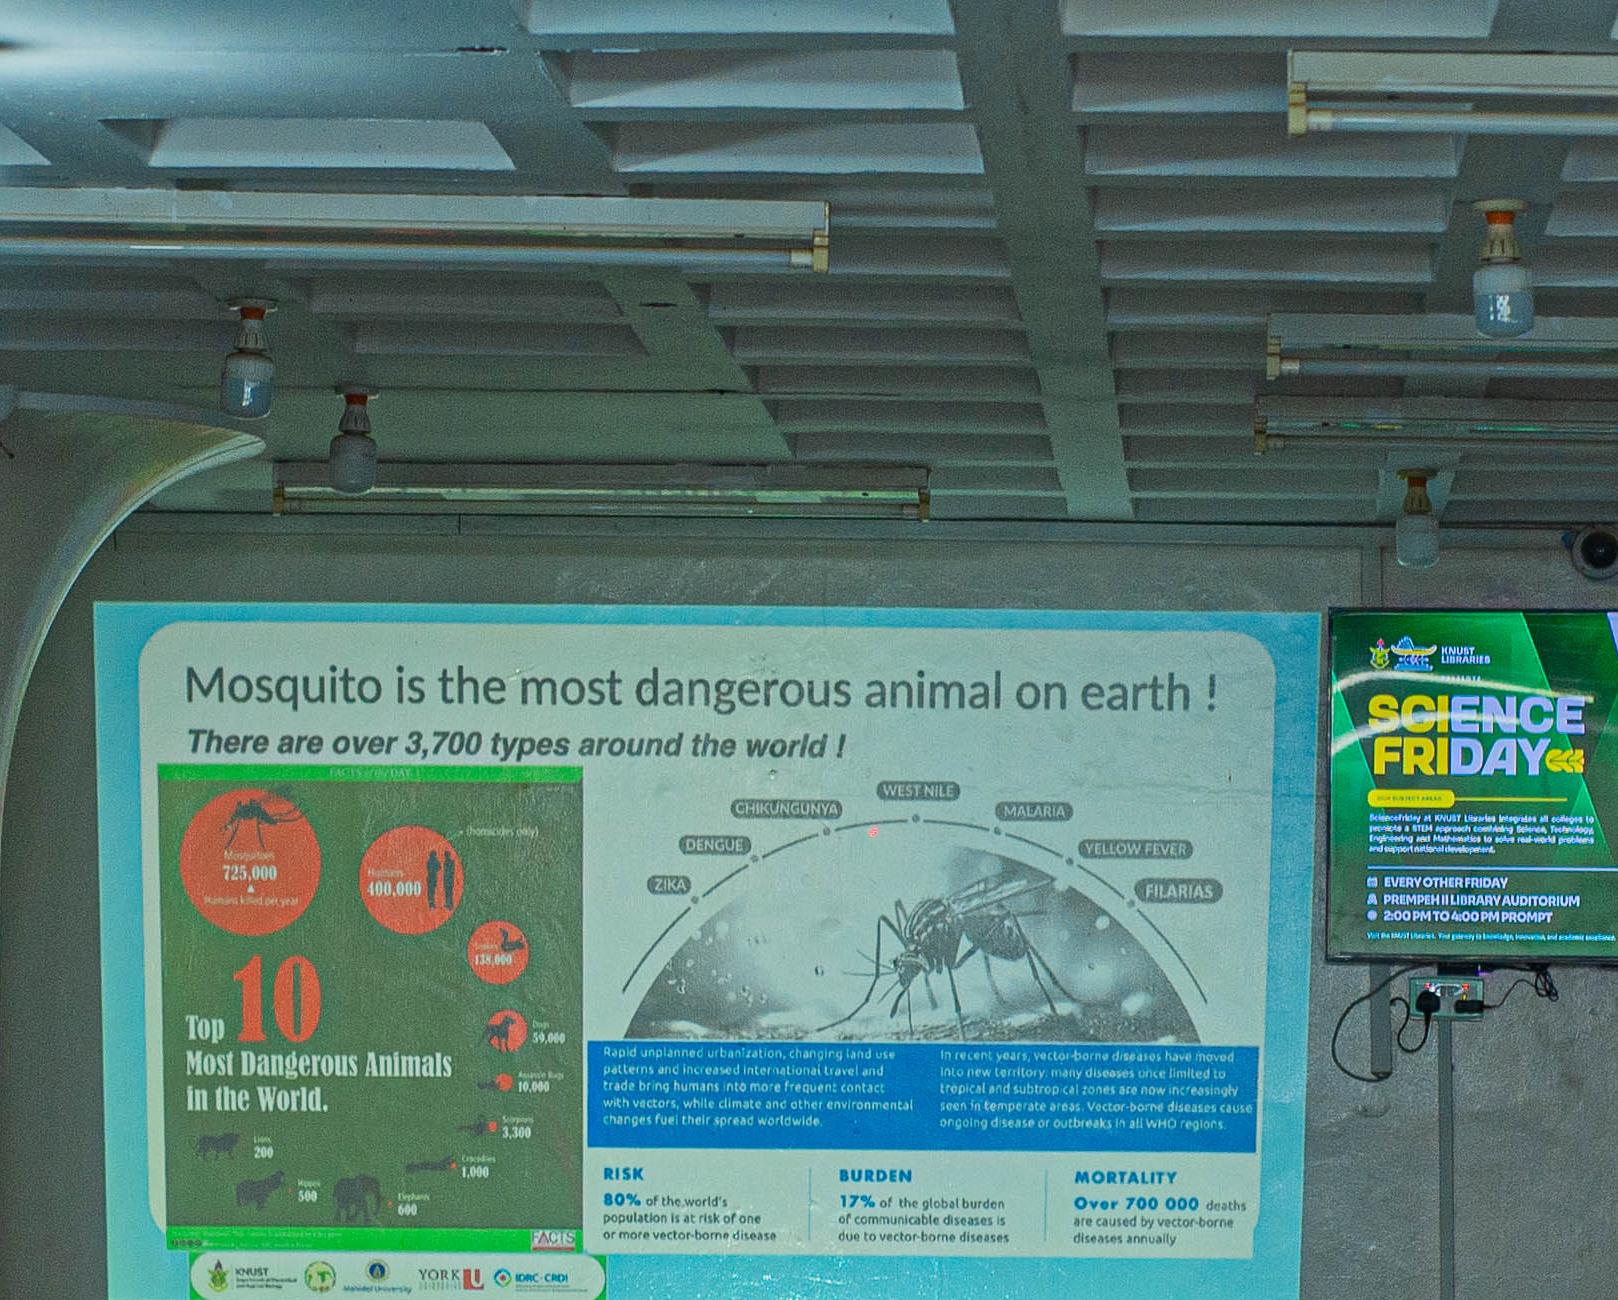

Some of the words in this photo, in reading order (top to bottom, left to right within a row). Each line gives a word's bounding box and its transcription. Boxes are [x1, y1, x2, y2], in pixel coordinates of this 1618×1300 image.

[1441, 646, 1475, 655] KNUST
[1441, 655, 1490, 664] LIBRARIES
[186, 665, 382, 711] Mosquito
[396, 665, 425, 705] is
[438, 667, 506, 706] the
[521, 671, 621, 706] most
[636, 667, 851, 715] dangerous
[865, 670, 1002, 709] animal
[1016, 681, 1067, 710] on
[1081, 672, 1190, 712] earth
[1207, 673, 1216, 712] !
[1369, 695, 1585, 734] SCIENCE
[188, 729, 269, 754] There
[277, 735, 323, 755] are
[333, 736, 397, 755] over
[405, 731, 482, 760] 3,700
[491, 733, 570, 762] types
[579, 733, 683, 757] around
[692, 733, 735, 757] the
[747, 734, 827, 758] world
[836, 734, 846, 758] !
[1373, 737, 1551, 775] FRIDAY
[882, 786, 920, 796] WEST
[924, 785, 954, 797] NILE
[736, 804, 838, 815] CHIKUNGUNYA
[1004, 806, 1066, 817] MALARIA
[686, 839, 744, 850] DENGUE
[1084, 844, 1140, 855] YELLOW
[1145, 844, 1186, 856] FEVER
[223, 865, 277, 883] 725,000
[367, 881, 421, 897] 400,000
[654, 880, 686, 890] ZIKA
[1384, 877, 1421, 888] EVERY
[1423, 877, 1463, 888] OTHER
[1464, 877, 1508, 889] FRIDAY
[1146, 884, 1213, 898] FILARIAS
[1384, 894, 1440, 905] PREMPEH
[1442, 895, 1448, 905] II
[1451, 895, 1502, 906] LIBRARY
[1502, 895, 1580, 907] AUDITORIUM
[1384, 911, 1411, 921] 2:00
[1413, 911, 1431, 921] PM
[1433, 911, 1450, 921] TO
[1451, 911, 1479, 921] 4:00
[1481, 911, 1500, 922] PM
[1501, 911, 1552, 923] PROMPT
[233, 955, 321, 1043] 10
[186, 1015, 225, 1043] Top
[603, 1047, 637, 1059] Rapid
[640, 1047, 703, 1059] unplanned
[790, 1049, 843, 1061] changing
[847, 1049, 871, 1059] land
[876, 1051, 895, 1059] use
[186, 1052, 233, 1076] Most
[241, 1052, 358, 1079] Dangerous
[364, 1052, 452, 1078] Animals
[603, 1064, 654, 1076] patterns
[658, 1065, 679, 1075] and
[683, 1064, 740, 1075] increased
[862, 1065, 883, 1076] and
[603, 1080, 635, 1092] trade
[639, 1081, 669, 1093] bring
[674, 1081, 719, 1092] humans
[750, 1083, 780, 1092] more
[841, 1083, 885, 1093] contact
[186, 1087, 203, 1111] in
[215, 1087, 250, 1112] the
[257, 1087, 328, 1113] World.
[603, 1098, 629, 1108] with
[633, 1098, 679, 1110] vectors,
[683, 1098, 714, 1109] while
[718, 1098, 761, 1109] climate
[766, 1099, 786, 1109] and
[791, 1099, 823, 1109] other
[827, 1100, 913, 1110] environmental
[603, 1114, 651, 1127] changes
[655, 1114, 678, 1125] fuel
[682, 1115, 710, 1125] their
[714, 1115, 753, 1128] spread
[758, 1116, 822, 1127] worldwide.
[502, 1127, 531, 1139] 3,300
[254, 1147, 274, 1159] 200
[462, 1167, 489, 1178] 1,000
[604, 1168, 644, 1180] RISK
[839, 1169, 912, 1182] BURDEN
[1075, 1171, 1177, 1184] MORTALITY
[298, 1190, 318, 1202] 500
[604, 1193, 641, 1206] 80%
[646, 1196, 658, 1206] of
[662, 1196, 681, 1207] the
[685, 1197, 728, 1207] world's
[841, 1195, 875, 1208] 17%
[880, 1197, 893, 1208] of
[899, 1198, 918, 1208] the
[923, 1198, 959, 1211] global
[962, 1199, 1005, 1209] burden
[1074, 1197, 1118, 1210] Over
[1126, 1197, 1158, 1210] 700
[1166, 1197, 1199, 1211] 000
[1206, 1201, 1246, 1211] deaths
[398, 1204, 417, 1216] 600
[604, 1213, 667, 1224] population
[671, 1214, 680, 1223] is
[683, 1214, 695, 1223] at
[699, 1214, 720, 1223] risk
[723, 1214, 736, 1224] of
[739, 1215, 761, 1224] one
[839, 1214, 851, 1224] of
[854, 1215, 939, 1225] communicable
[943, 1215, 993, 1226] diseases
[997, 1216, 1005, 1226] is
[1074, 1218, 1092, 1226] are
[1096, 1216, 1136, 1227] caused
[1141, 1217, 1154, 1229] by
[1157, 1217, 1234, 1228] vector-borne
[533, 1231, 575, 1244] FACTS
[604, 1231, 616, 1240] or
[619, 1232, 650, 1240] more
[653, 1230, 729, 1241] vector-borne
[733, 1231, 776, 1241] disease
[839, 1231, 860, 1241] due
[864, 1232, 876, 1241] to
[880, 1232, 955, 1243] vector-borne
[960, 1232, 1009, 1243] diseases
[1074, 1233, 1123, 1243] diseases
[1127, 1234, 1176, 1246] annually
[235, 1268, 268, 1276] KNUST
[418, 1269, 460, 1280] YORK
